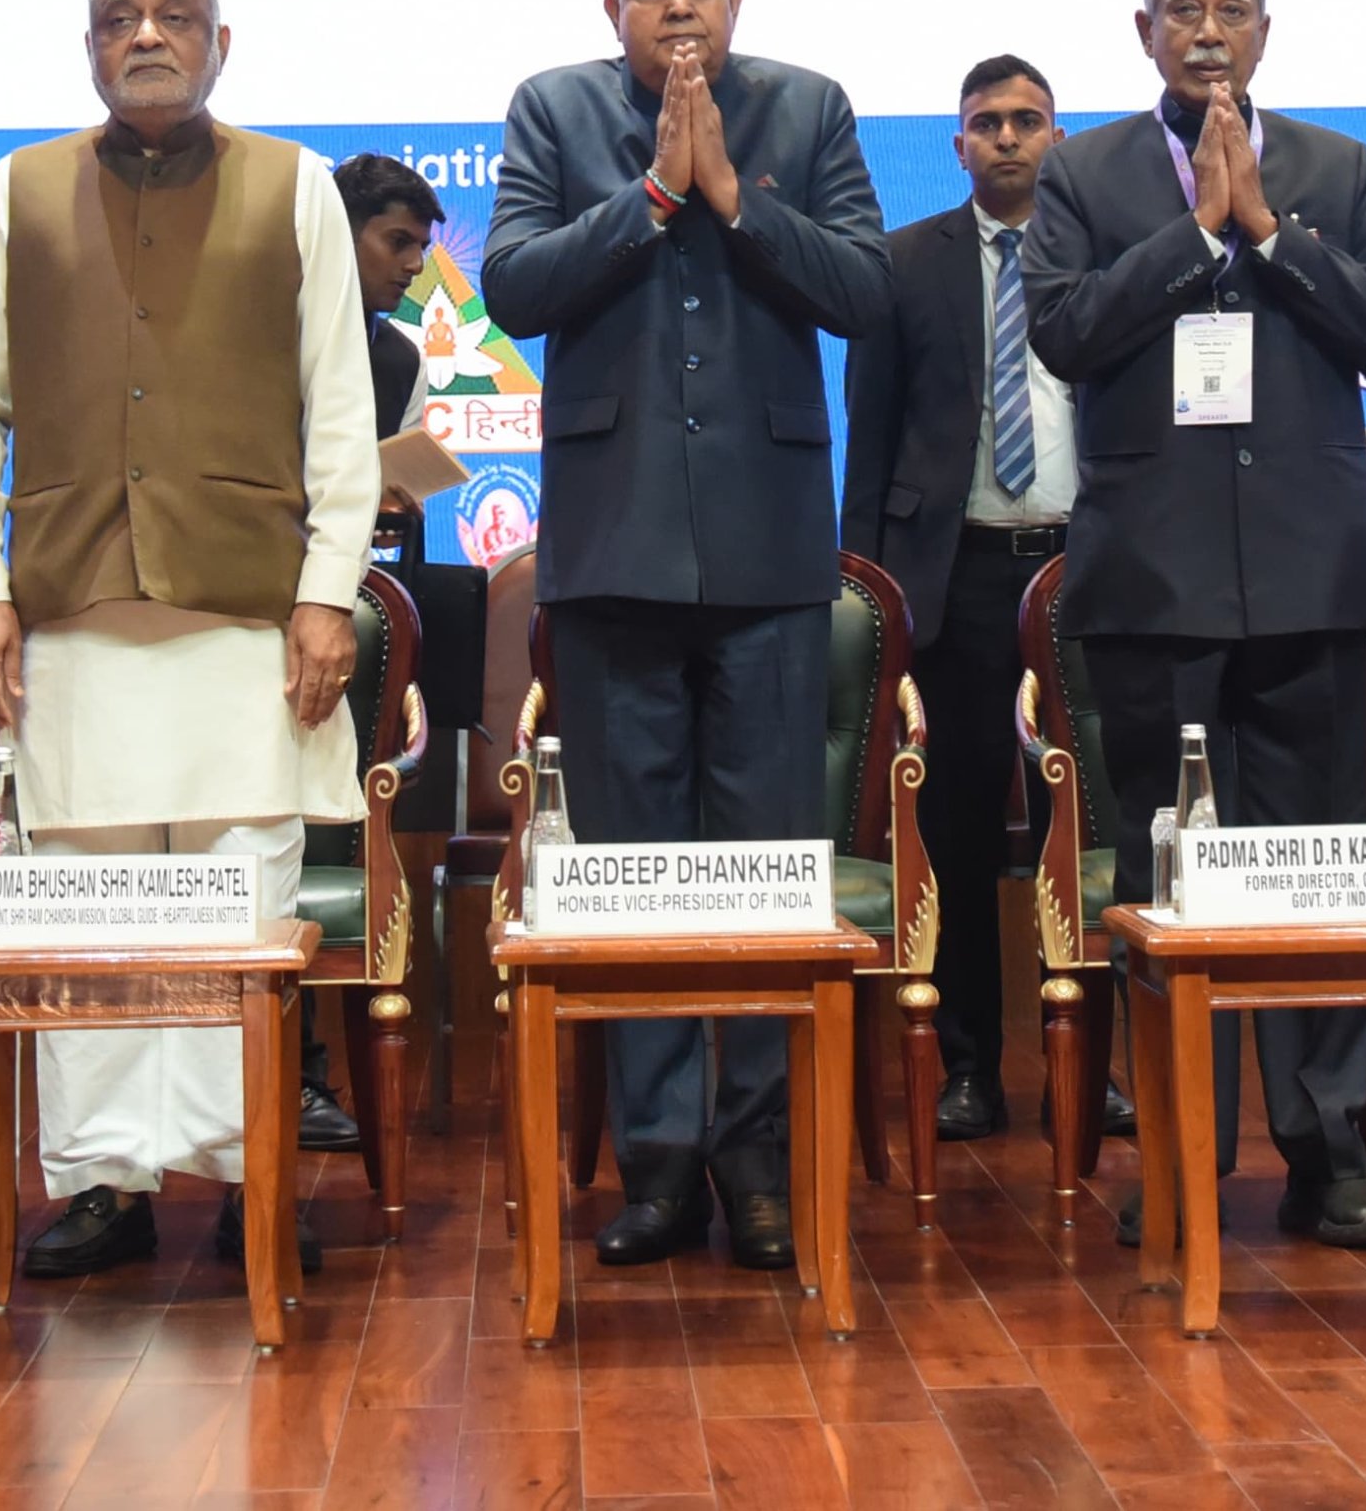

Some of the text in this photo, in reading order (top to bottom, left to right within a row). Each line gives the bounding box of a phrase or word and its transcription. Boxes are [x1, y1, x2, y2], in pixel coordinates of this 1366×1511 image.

[464, 399, 542, 441] हिन्दी
[1197, 840, 1259, 869] PADMA
[1265, 838, 1306, 867] SHRI
[1313, 838, 1343, 865] D.R
[29, 869, 96, 898] BHUSHAN
[101, 868, 133, 897] SHRI
[138, 867, 203, 897] KAMLESH
[208, 867, 249, 896] PATEL
[553, 853, 817, 886] JAGDEEP DHANKHAR
[1245, 875, 1293, 890] FORMER
[1298, 872, 1359, 889] DIRECTOR,
[557, 892, 812, 913] HON'BLE VICE-PRESIDENT OF INDIA
[1292, 892, 1323, 908] GOVT.
[1328, 892, 1342, 907] OF
